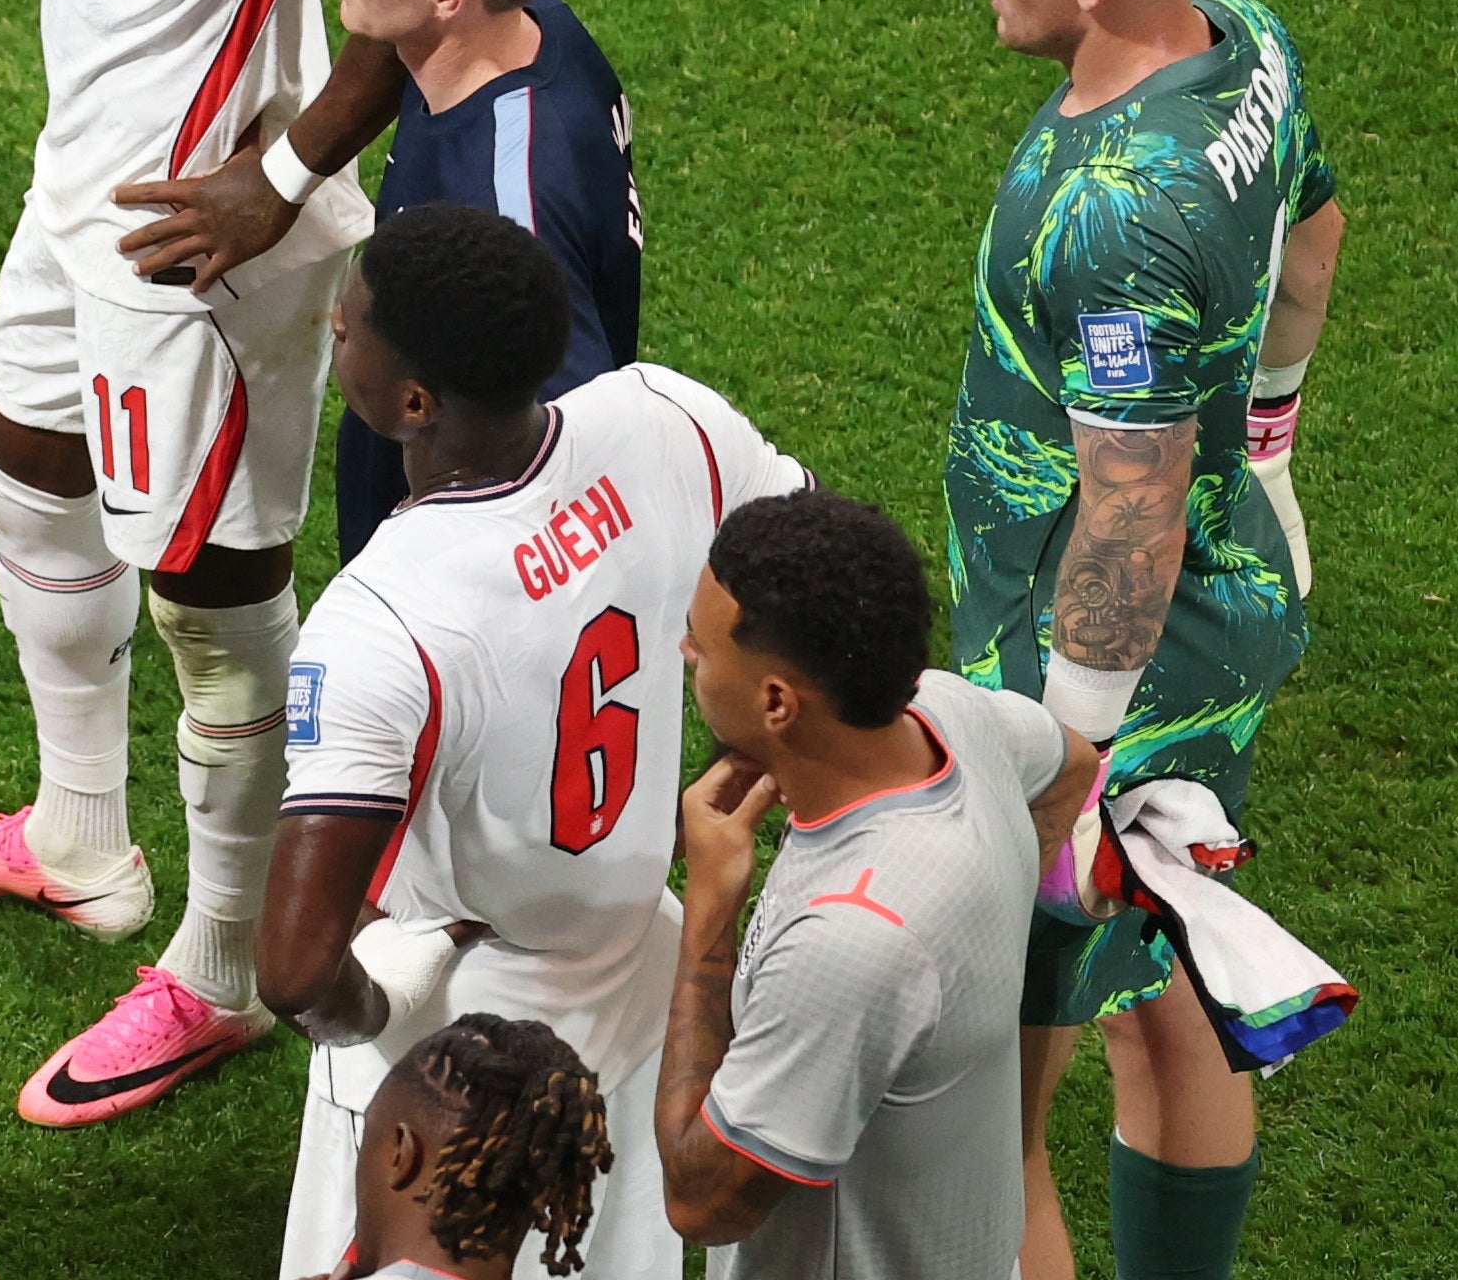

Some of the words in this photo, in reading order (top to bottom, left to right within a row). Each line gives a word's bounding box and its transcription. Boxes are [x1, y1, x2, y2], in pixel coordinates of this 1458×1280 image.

[1087, 322, 1134, 338] FOOTBALL
[1089, 334, 1136, 354] UNITES
[1091, 353, 1108, 368] the
[1107, 350, 1141, 369] World
[92, 373, 150, 495] 11
[513, 475, 634, 603] GUÉHI
[550, 604, 640, 856] 6
